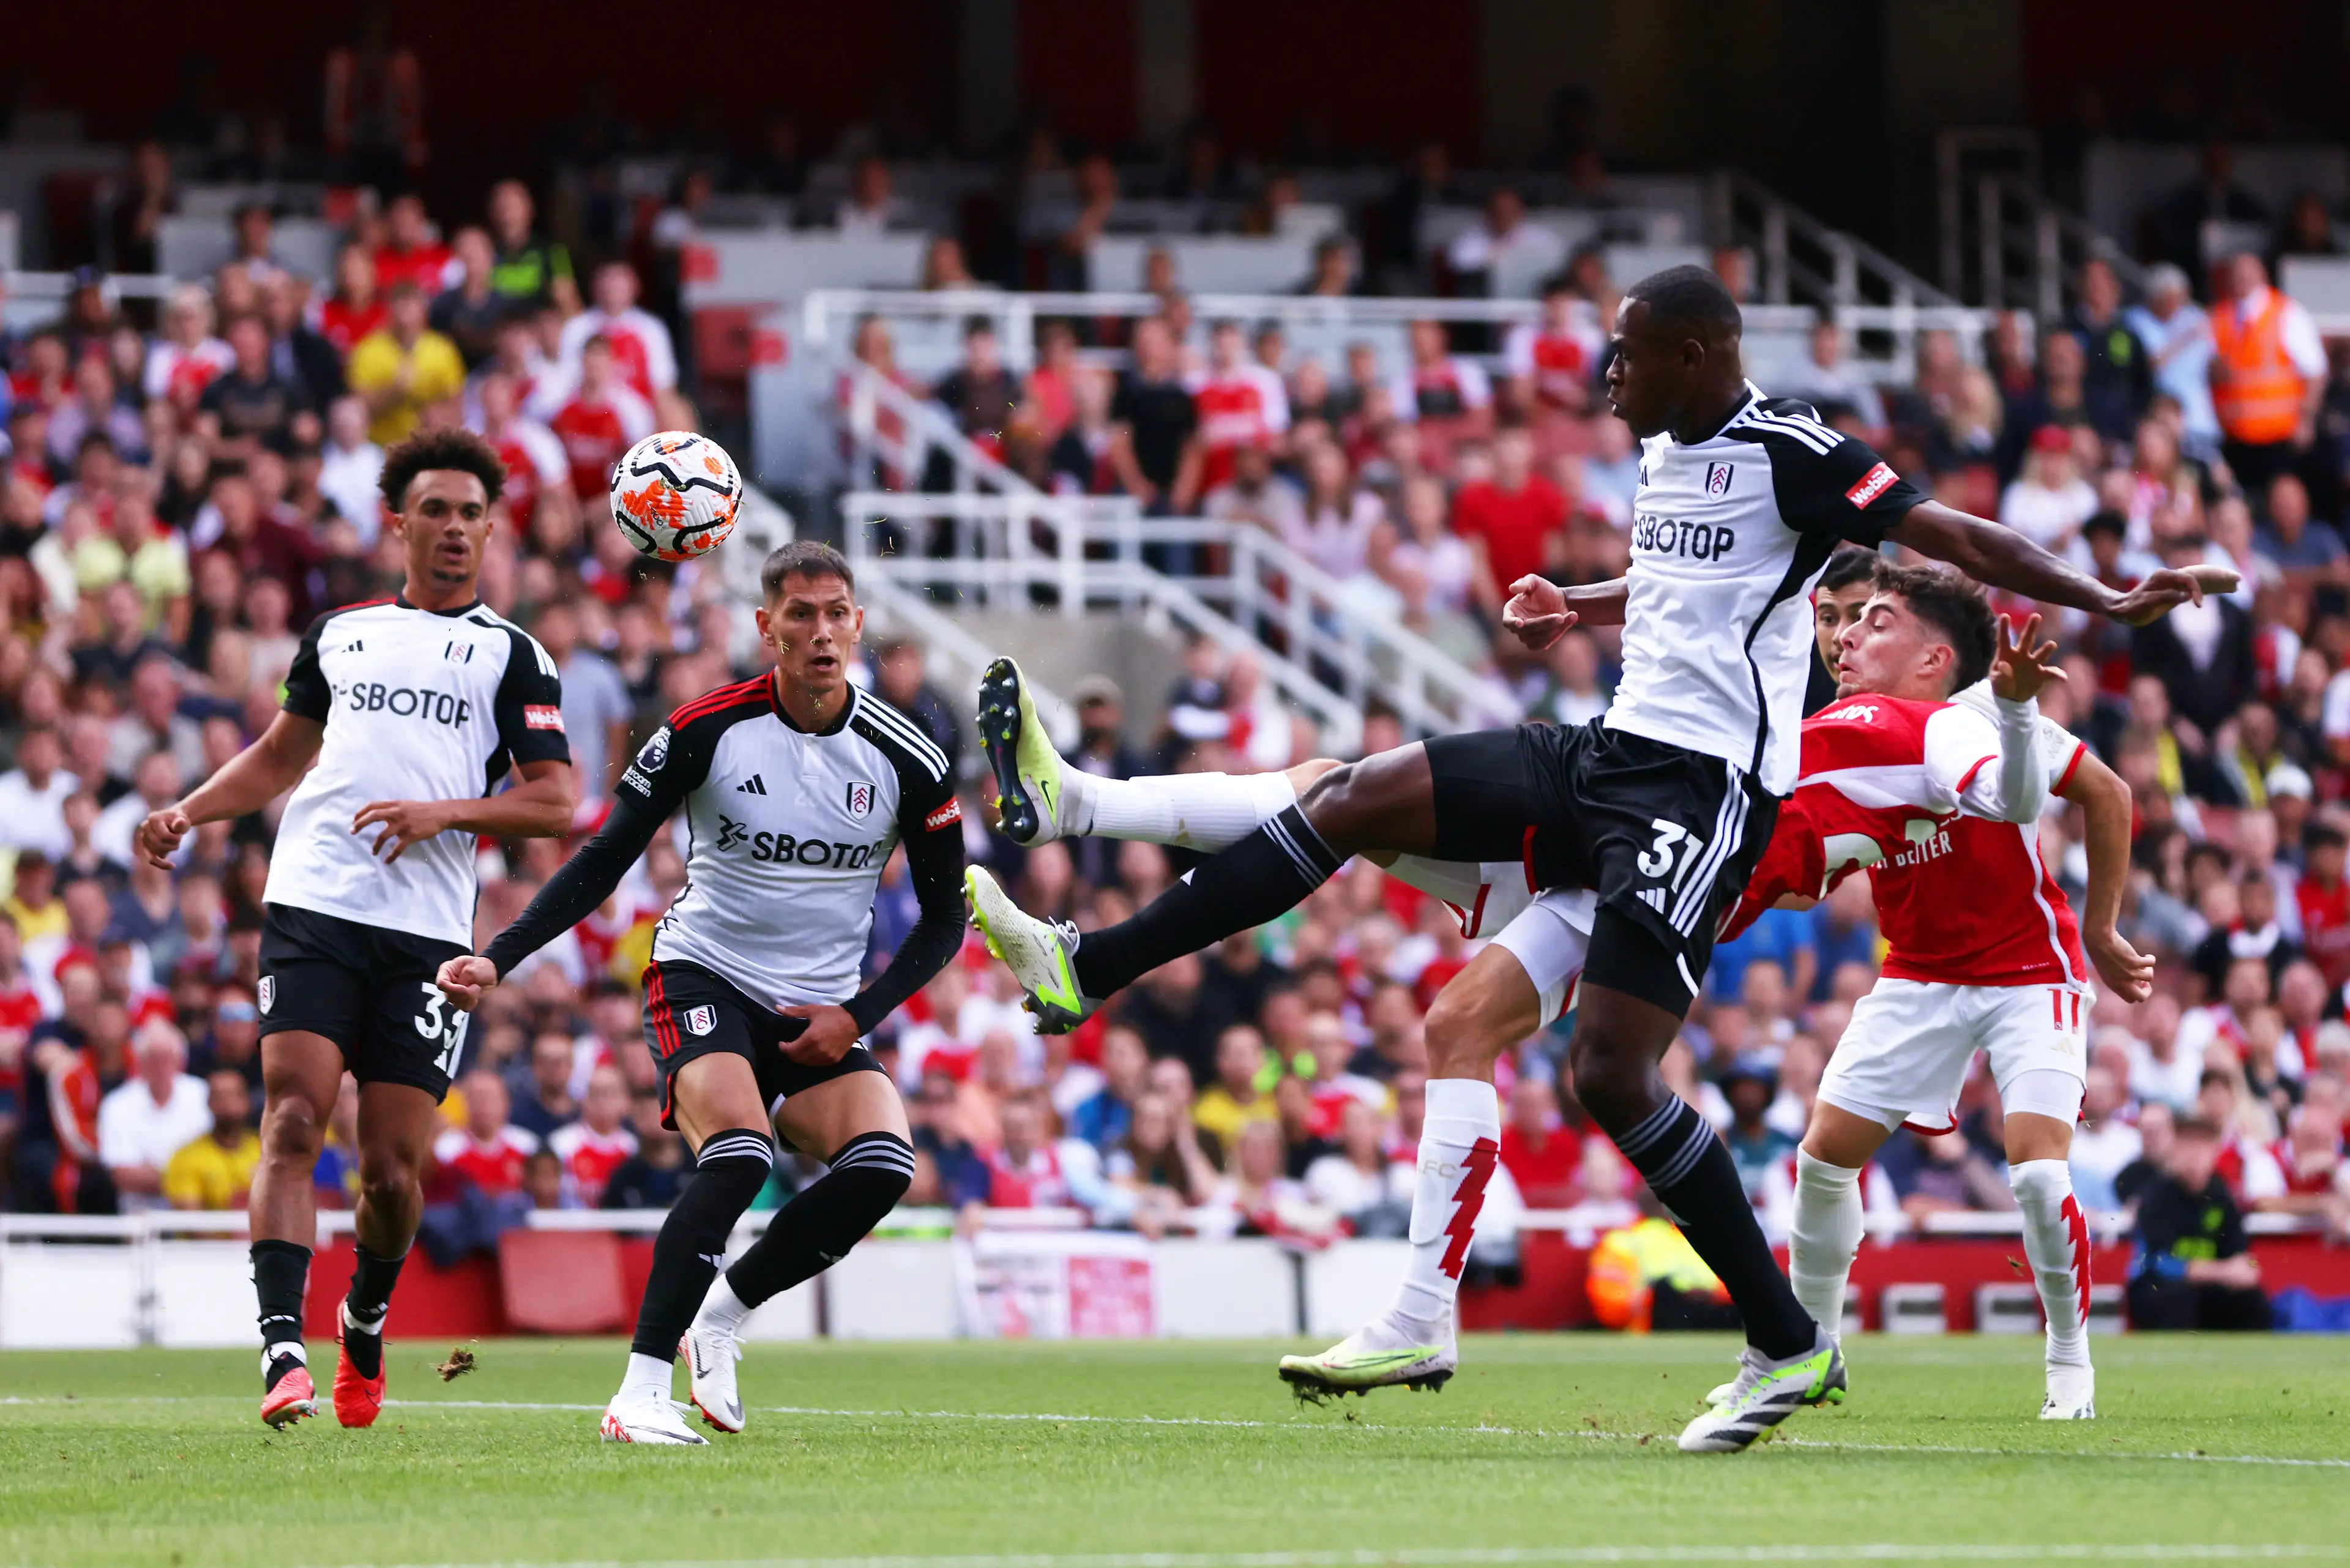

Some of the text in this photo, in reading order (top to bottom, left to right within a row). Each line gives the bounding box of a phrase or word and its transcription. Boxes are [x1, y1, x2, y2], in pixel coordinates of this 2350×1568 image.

[1636, 515, 1734, 562] SBOTOP
[350, 682, 469, 729] SBOTOP
[752, 831, 884, 869] SBOTOP
[1637, 818, 1704, 894] 31
[2046, 988, 2080, 1034] 11
